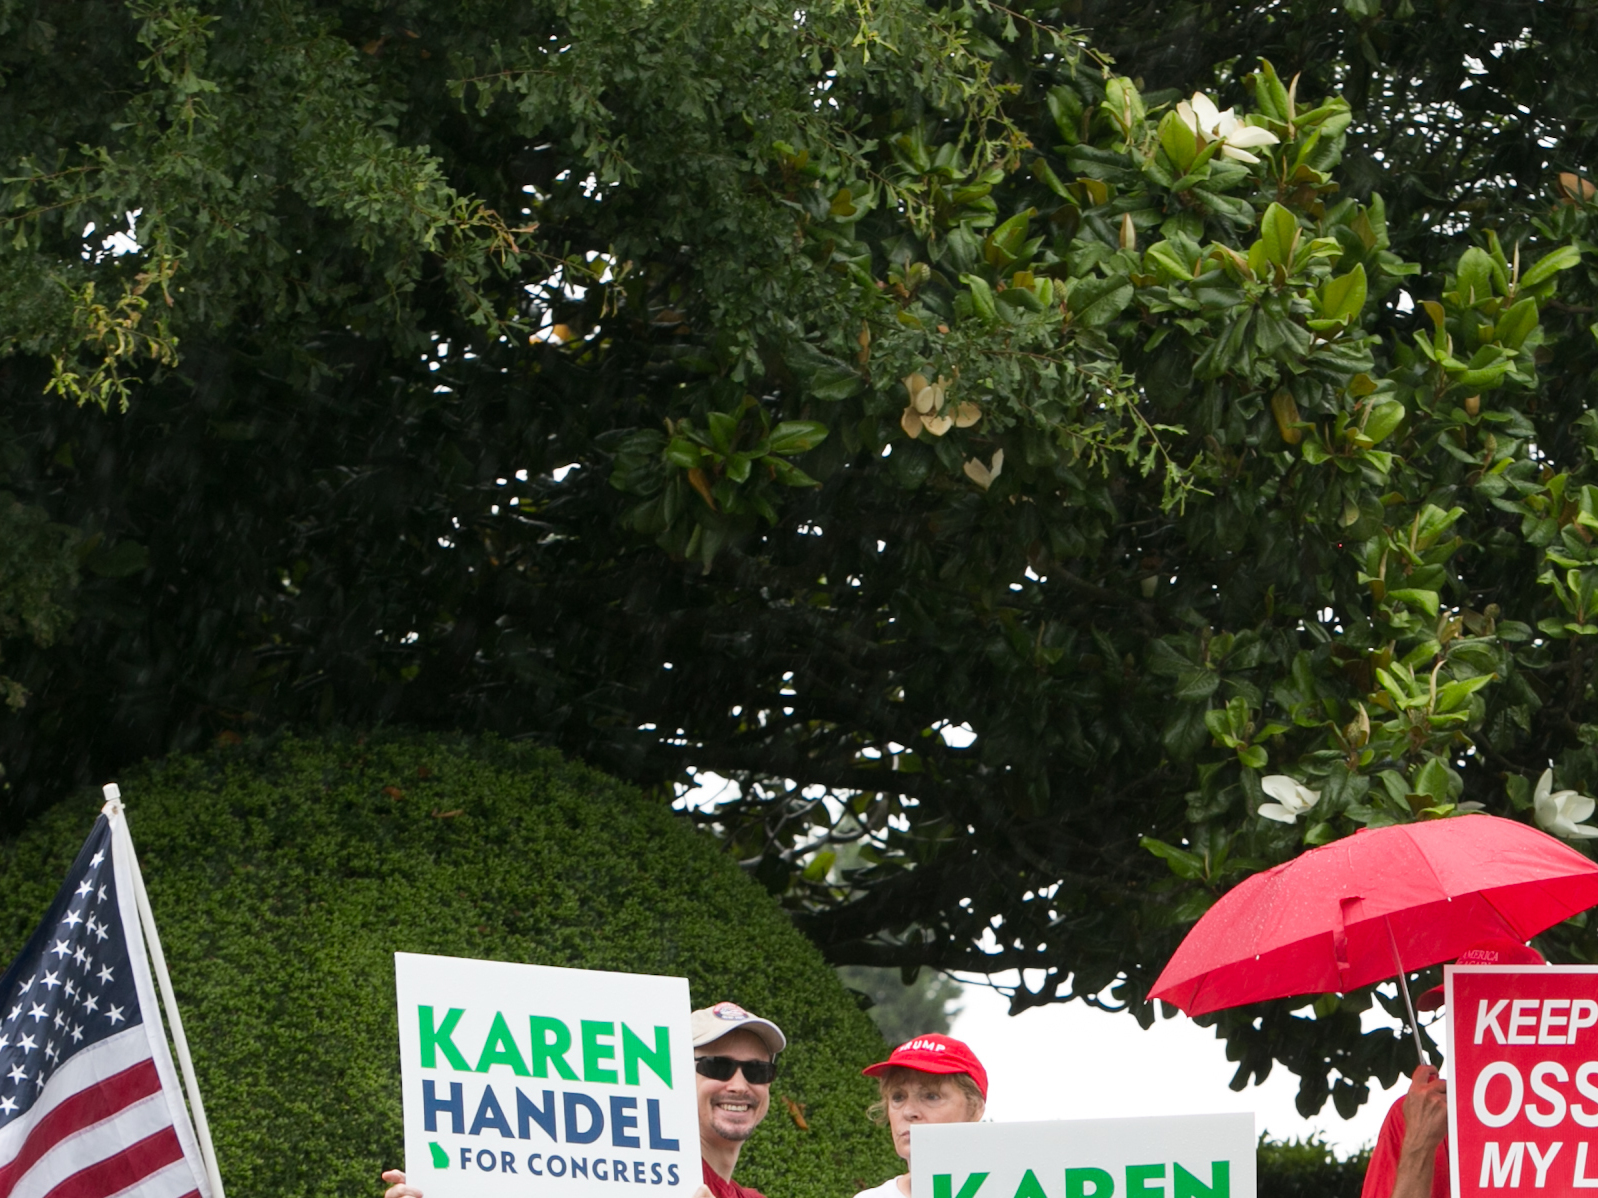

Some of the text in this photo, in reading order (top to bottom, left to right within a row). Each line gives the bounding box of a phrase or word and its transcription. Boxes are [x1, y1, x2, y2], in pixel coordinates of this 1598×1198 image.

[1462, 949, 1499, 962] AMERICA
[1474, 999, 1598, 1045] KEEP
[417, 1005, 673, 1089] KAREN
[422, 1079, 680, 1152] HANDEL
[460, 1147, 680, 1186] FOR CONGRESS
[1479, 1142, 1563, 1188] MY
